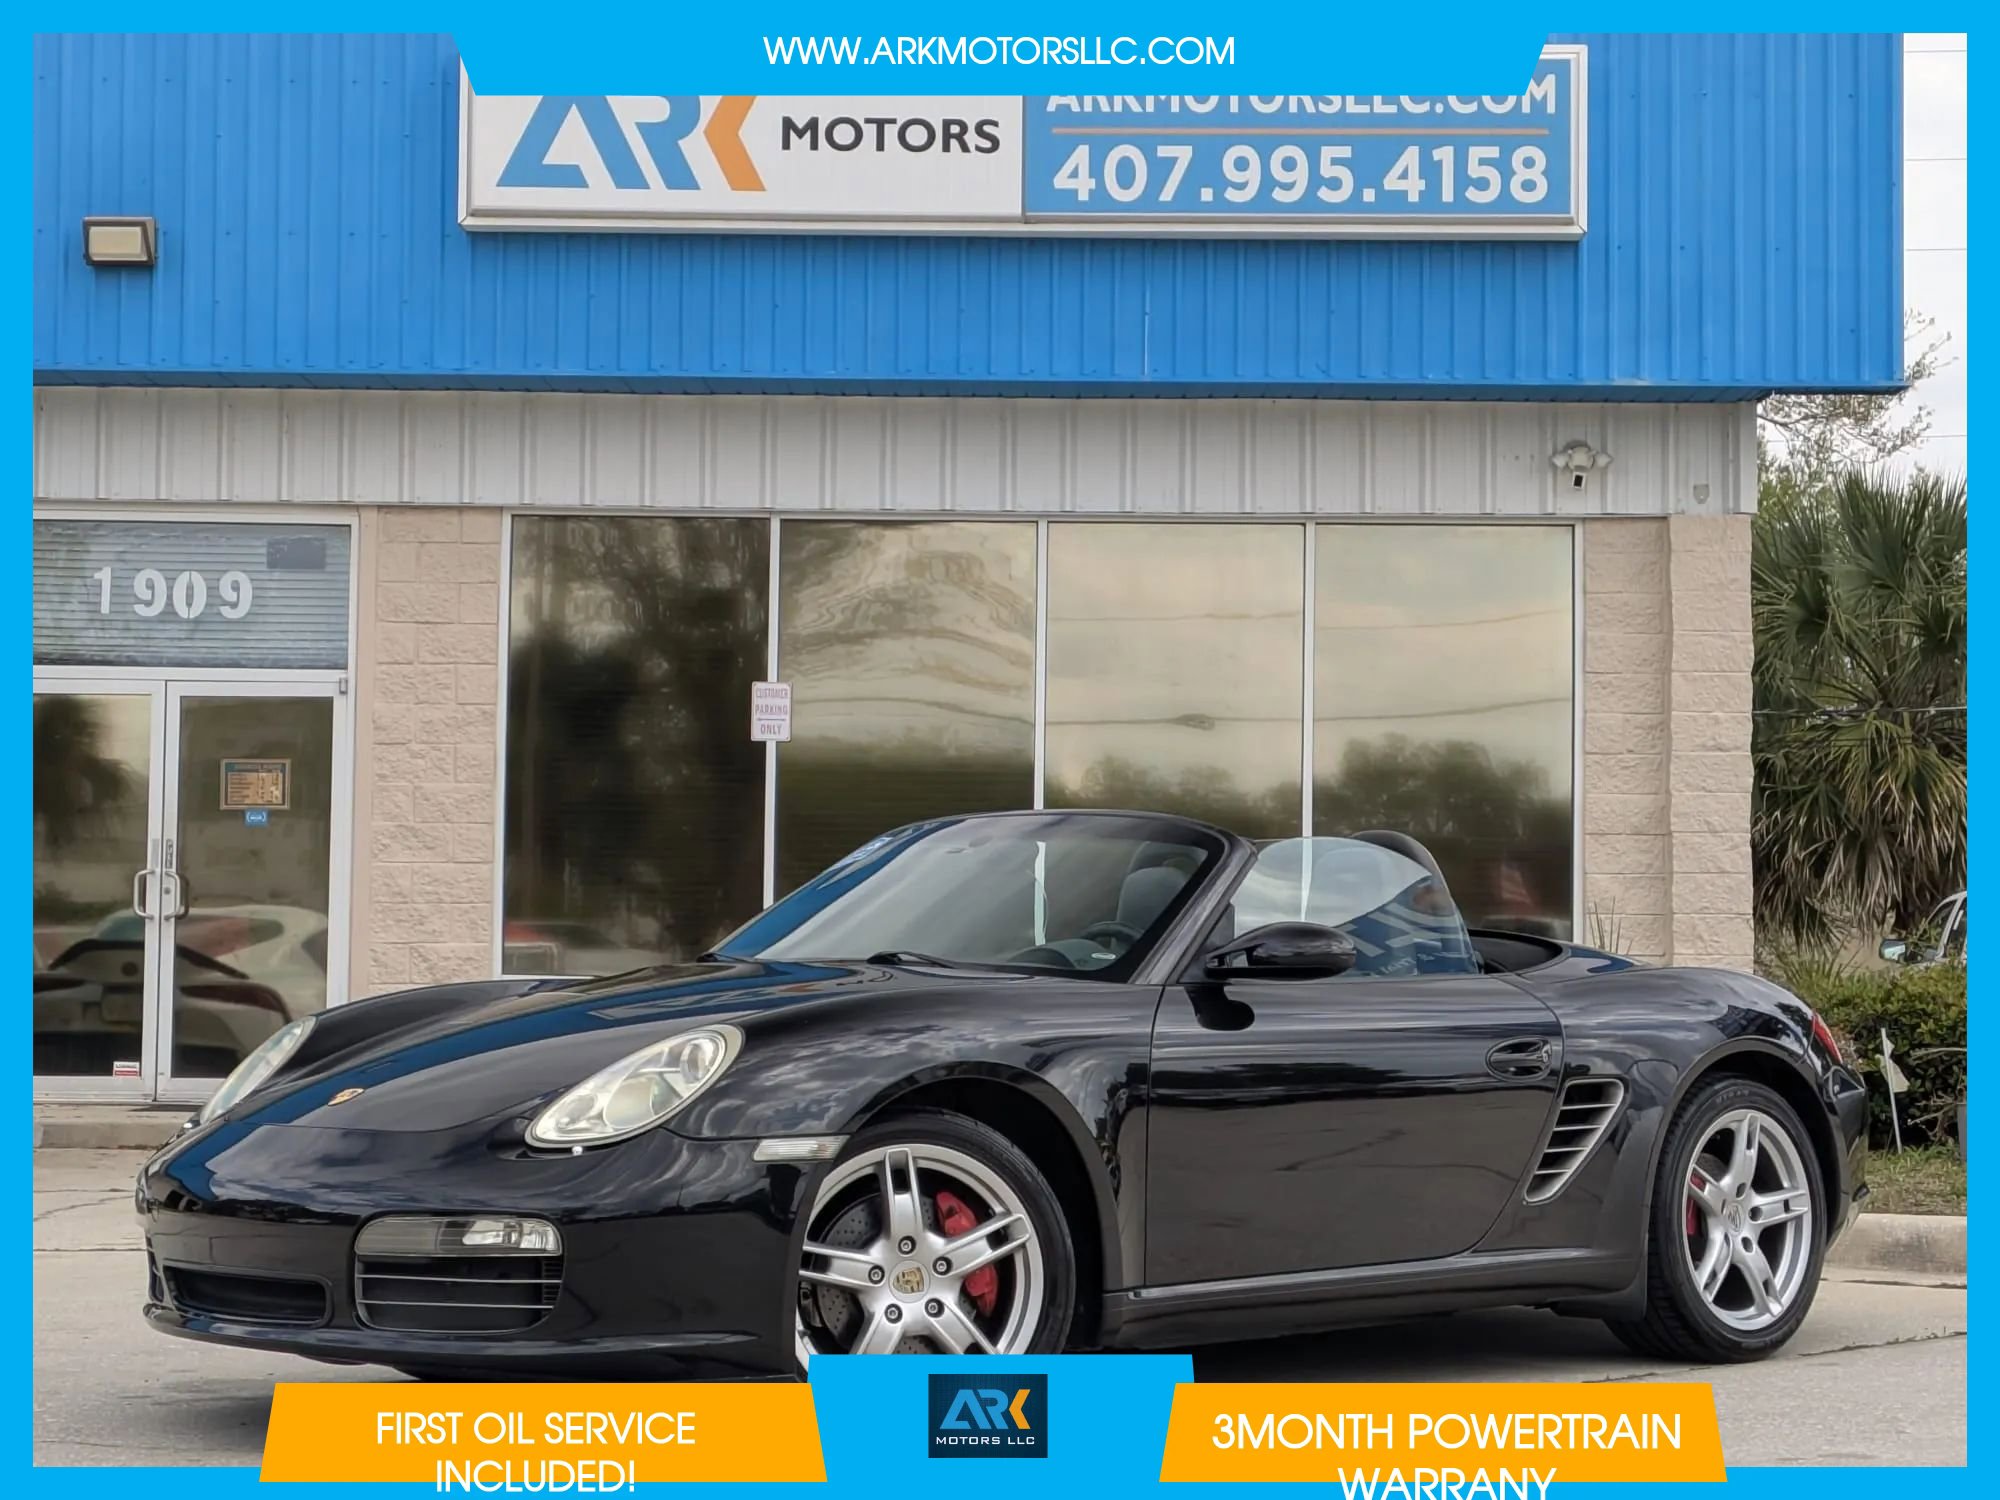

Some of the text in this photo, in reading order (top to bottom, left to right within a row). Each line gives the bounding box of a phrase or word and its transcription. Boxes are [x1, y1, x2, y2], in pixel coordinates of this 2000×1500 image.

[496, 95, 1001, 192] ARK MOTORS
[1053, 144, 1549, 204] 407.995.4158
[93, 565, 253, 620] 1909
[755, 704, 788, 716] PARKING
[760, 724, 783, 736] ONLY
